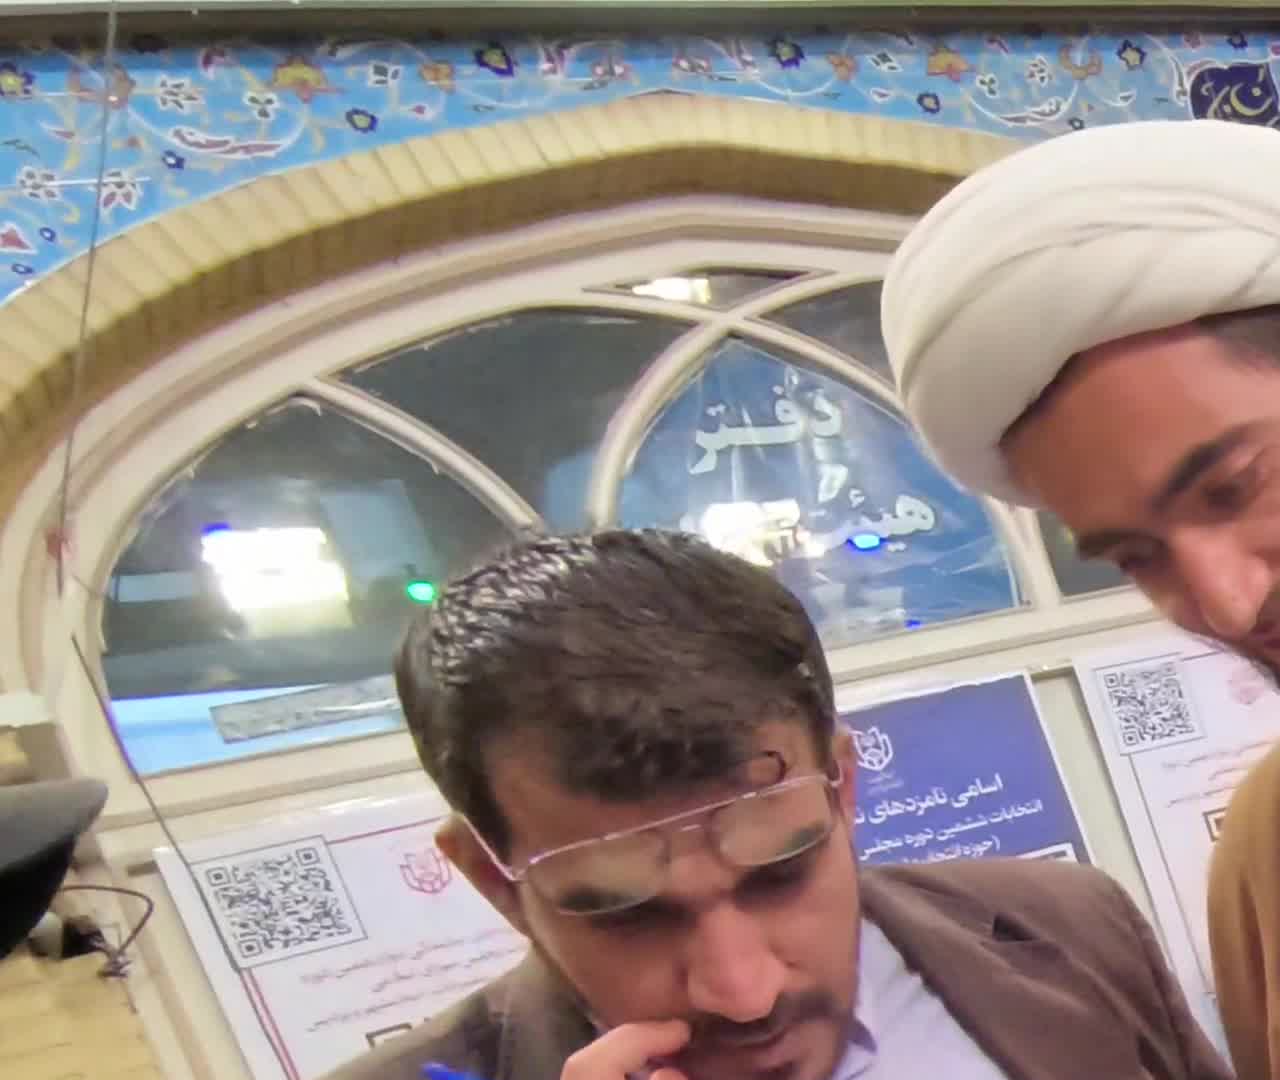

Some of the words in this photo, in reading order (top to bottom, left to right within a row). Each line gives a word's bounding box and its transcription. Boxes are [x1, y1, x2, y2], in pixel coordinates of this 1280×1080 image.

[689, 385, 843, 476] دفتر
[951, 773, 1003, 808] اسامی
[868, 786, 948, 824] نامزدهای
[989, 799, 1043, 824] انتخابات
[904, 828, 934, 847] دوره
[935, 816, 989, 840] ششمین
[859, 837, 903, 862] مجلس
